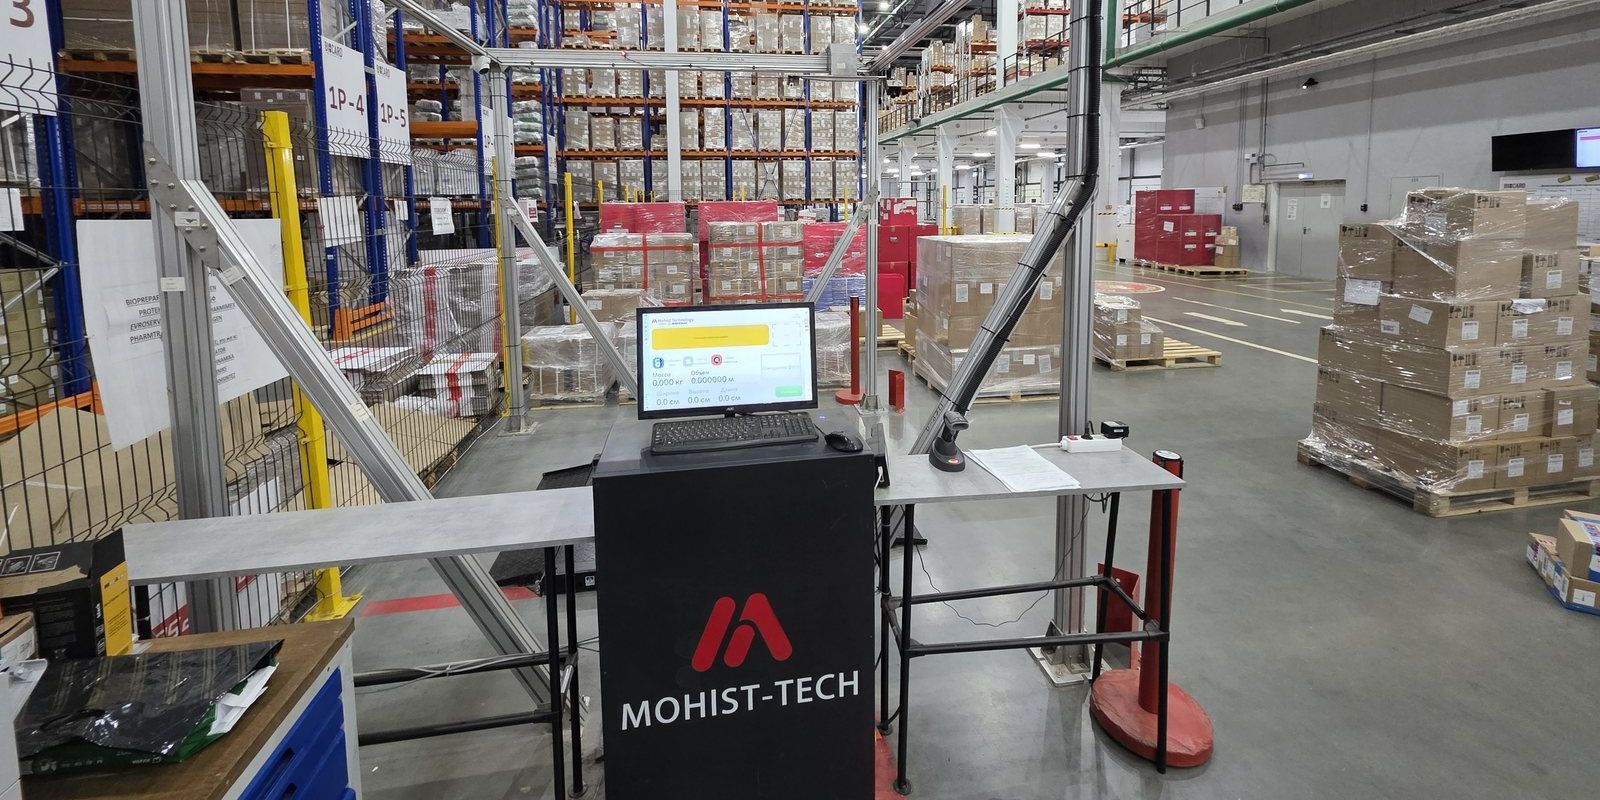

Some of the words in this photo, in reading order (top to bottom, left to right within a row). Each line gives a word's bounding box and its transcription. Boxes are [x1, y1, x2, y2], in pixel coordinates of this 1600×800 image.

[329, 86, 365, 116] 1P-4
[380, 102, 407, 128] 1P-5
[621, 670, 860, 730] MOHIST-TECH
